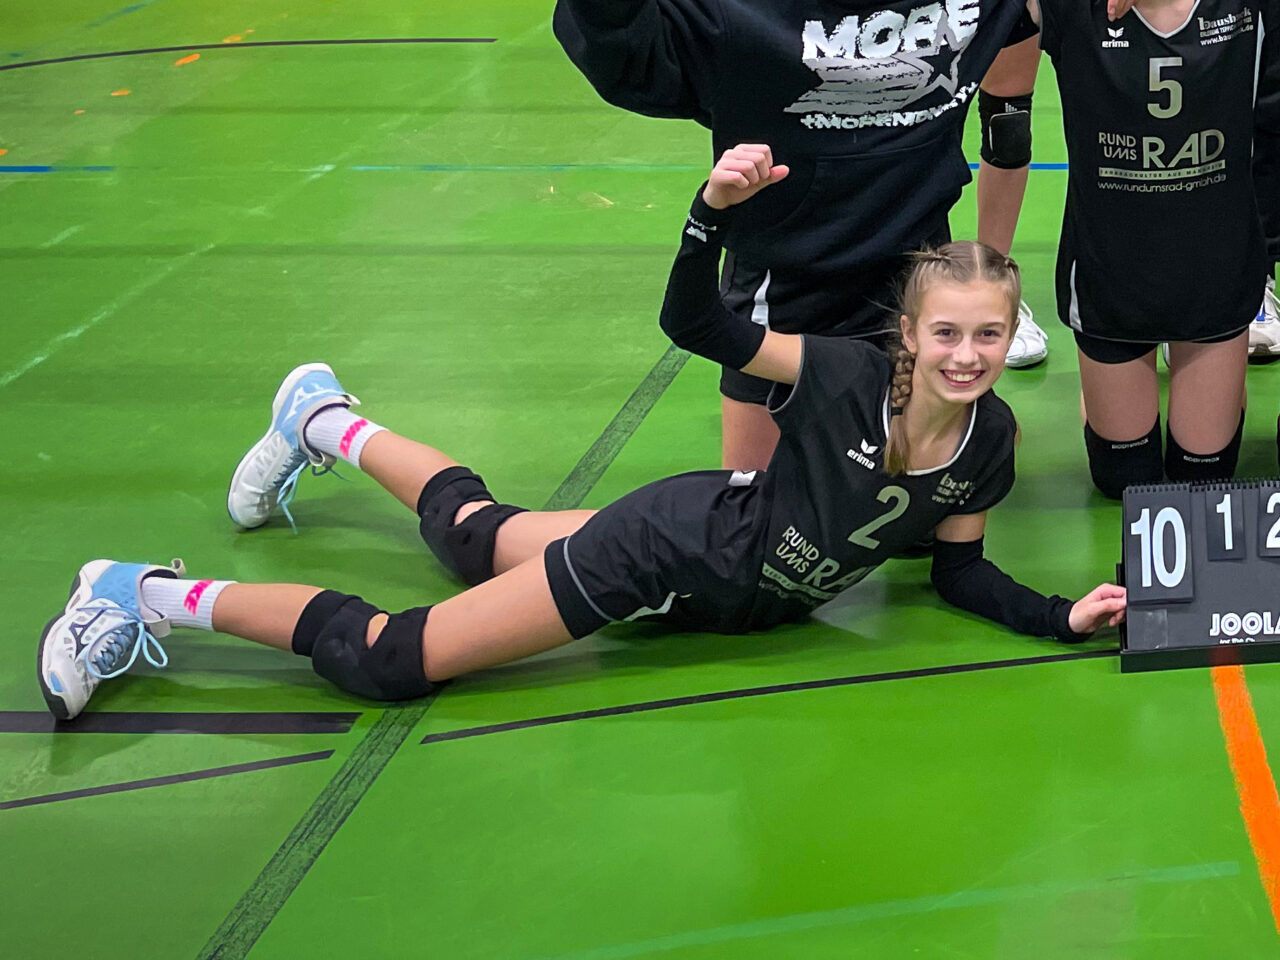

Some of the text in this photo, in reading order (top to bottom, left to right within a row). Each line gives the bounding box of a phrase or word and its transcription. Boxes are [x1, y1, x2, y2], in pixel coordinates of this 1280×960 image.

[1101, 40, 1129, 48] erima
[1147, 56, 1183, 119] 5
[1098, 131, 1136, 147] RUND
[1103, 146, 1137, 160] UMS
[1142, 128, 1225, 169] RAD
[1098, 173, 1226, 193] www.rundumsrad-gmbh.de
[846, 448, 875, 470] erima
[848, 485, 911, 550] 2
[782, 525, 820, 561] RUND
[1131, 507, 1187, 587] 10
[1216, 494, 1233, 550] 1
[775, 542, 810, 574] UMS
[801, 557, 880, 591] RA
